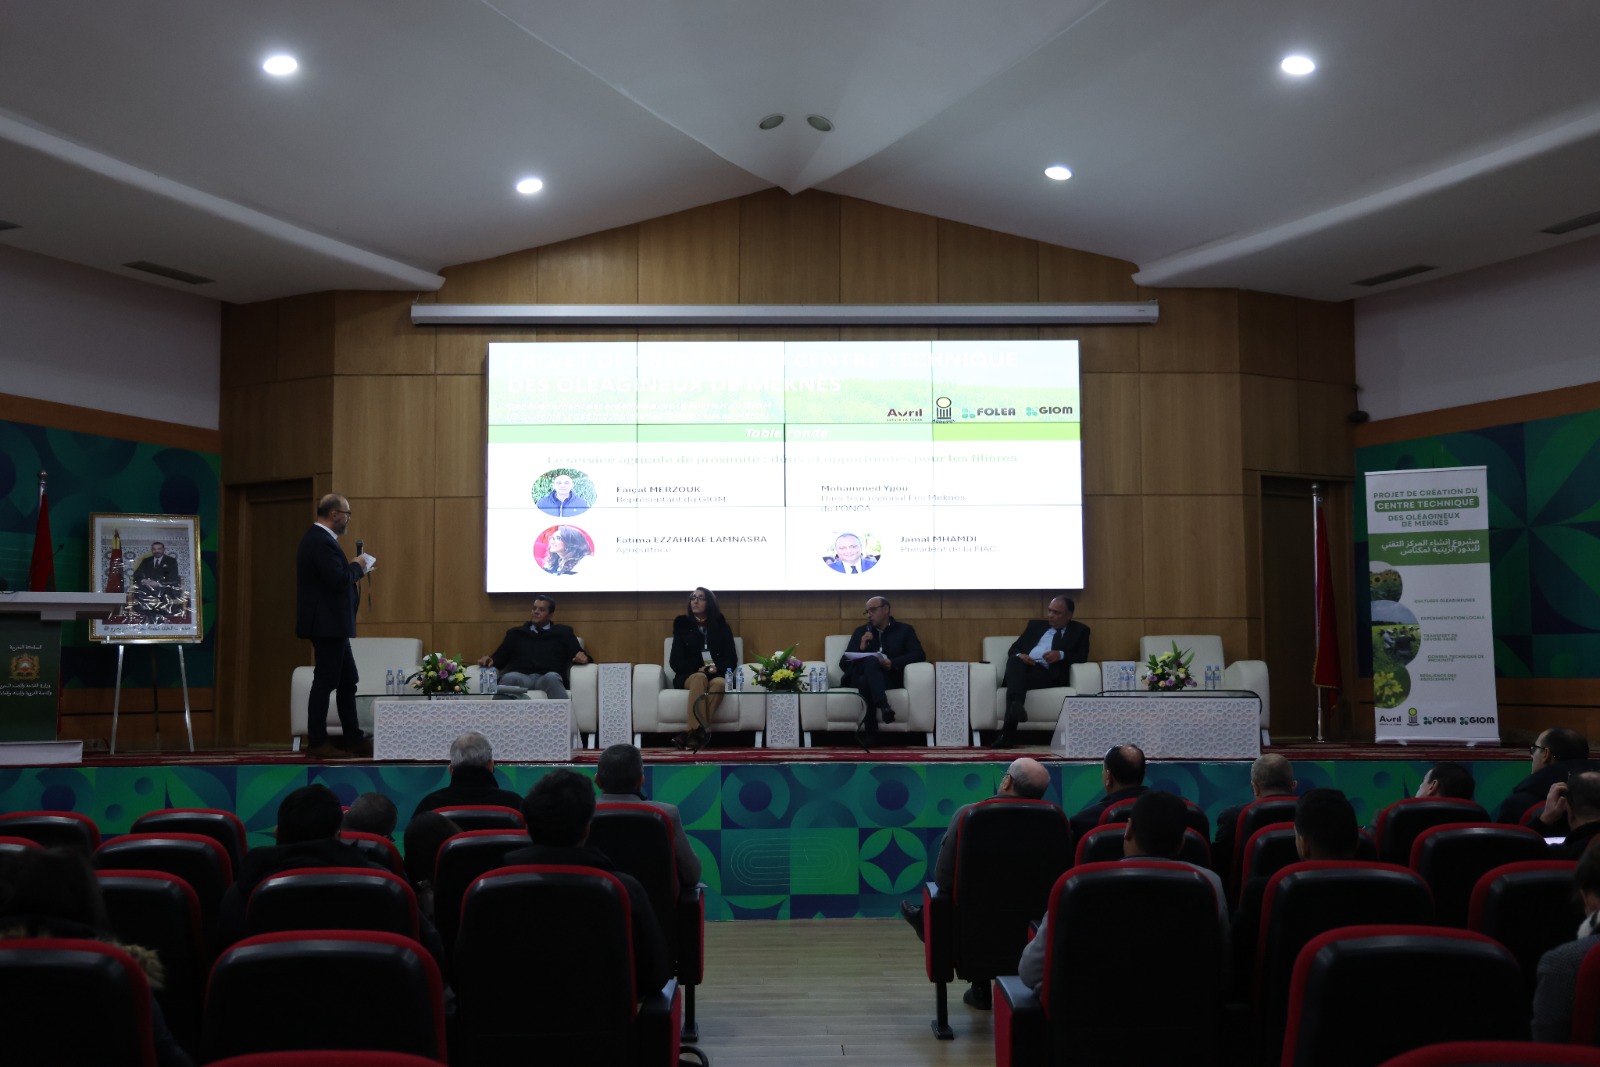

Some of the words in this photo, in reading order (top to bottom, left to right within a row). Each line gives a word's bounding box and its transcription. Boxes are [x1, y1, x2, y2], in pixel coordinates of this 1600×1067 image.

[795, 351, 881, 368] CENTRE
[887, 350, 1018, 368] TECHNIQUE
[508, 377, 549, 392] DES
[556, 374, 703, 392] OLÉAGINEUX
[748, 374, 841, 391] MEKNÈS
[887, 408, 922, 417] Avril
[977, 408, 1016, 416] FOLEA
[1039, 406, 1073, 415] GIOM
[745, 428, 782, 439] Table
[787, 428, 829, 439] ronde
[547, 456, 562, 464] Le
[566, 456, 615, 464] service
[619, 455, 673, 466] agricole
[676, 456, 692, 464] de
[697, 455, 760, 466] proximité
[915, 455, 945, 465] pour
[948, 453, 968, 462] les
[972, 453, 1018, 463] filières
[650, 485, 701, 493] MERZOUK
[821, 484, 881, 493] Mohammed
[1373, 490, 1405, 499] PROJET
[1407, 489, 1417, 497] DE
[1419, 488, 1464, 497] CRÉATION
[1465, 487, 1478, 495] DU
[699, 495, 726, 503] GIOM
[1376, 501, 1415, 510] CENTRE
[1417, 498, 1475, 509] TECHNIQUE
[1388, 514, 1404, 522] DES
[1405, 512, 1460, 521] OLÉAGINEUX
[1401, 520, 1413, 528] DE
[616, 536, 651, 544] Fatima
[653, 536, 707, 544] EZZAHRAE
[710, 535, 767, 543] LAMNASRA
[900, 535, 930, 543] Jamal
[933, 535, 977, 543] MHAMDI
[1379, 715, 1402, 723] Avril
[1432, 716, 1457, 724] FOLEA
[1469, 716, 1496, 724] GIOM
